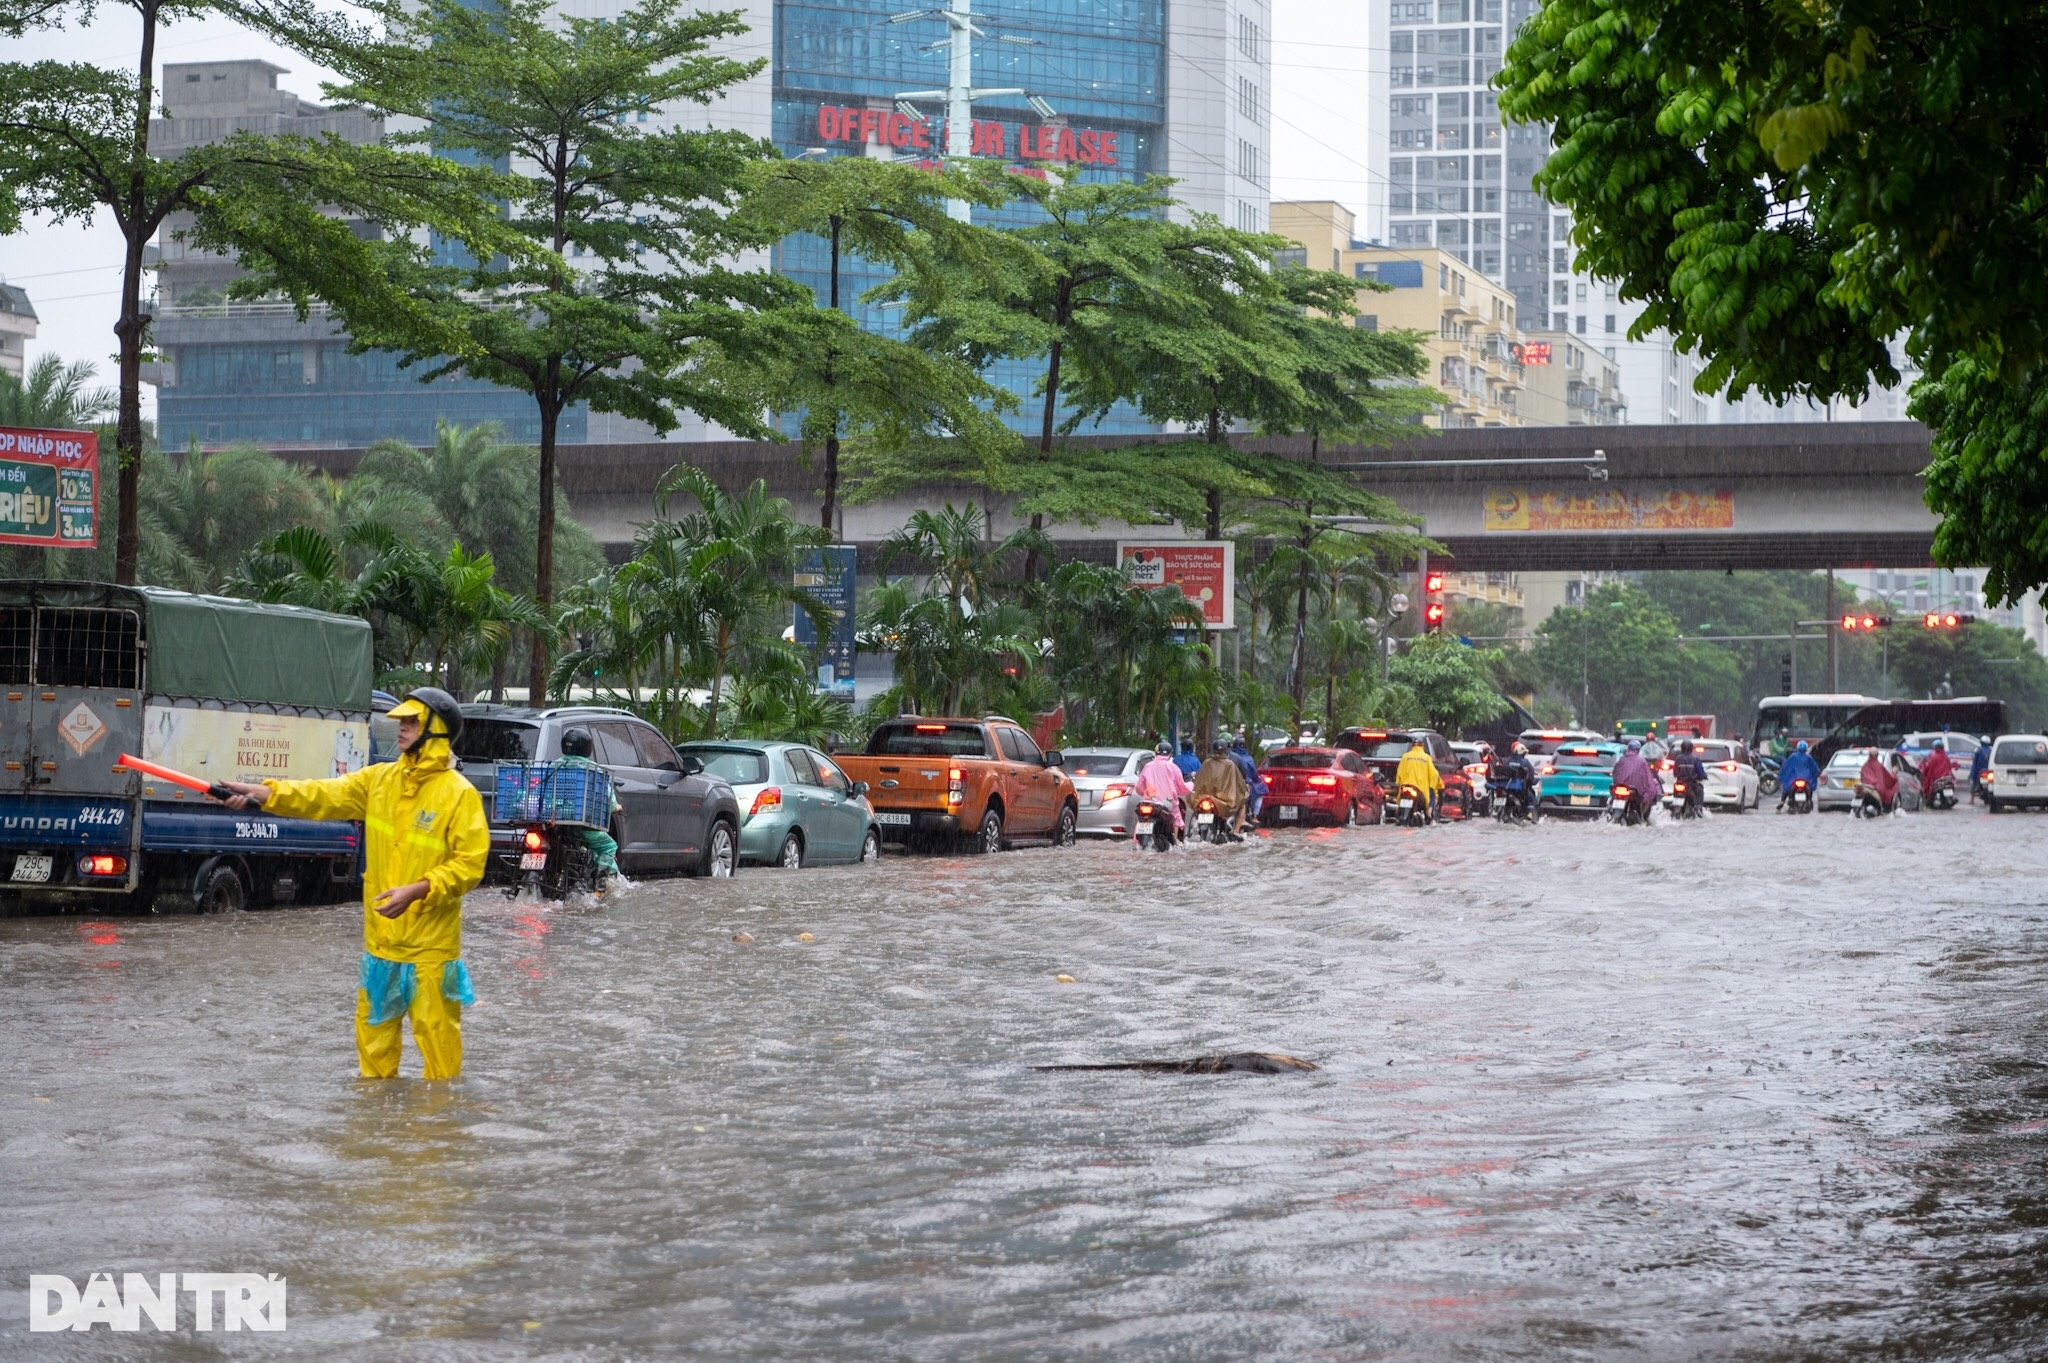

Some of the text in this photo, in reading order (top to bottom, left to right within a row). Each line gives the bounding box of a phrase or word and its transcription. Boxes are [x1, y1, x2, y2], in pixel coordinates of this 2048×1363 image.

[818, 105, 929, 148] OFFICE
[1019, 124, 1117, 165] LEASE
[17, 433, 53, 459] NHẬP
[56, 440, 82, 462] HỌC
[8, 465, 26, 483] ĐẾN
[61, 478, 91, 500] 10 %
[0, 485, 51, 531] RIỆU
[62, 514, 94, 537] 3 NĂ
[1174, 553, 1192, 562] THỰC
[811, 575, 824, 585] 18
[1135, 571, 1154, 579] herz
[238, 737, 250, 748] BIA
[237, 751, 260, 767] KEG
[263, 752, 269, 767] 2
[0, 816, 76, 831] UNDAI
[79, 806, 125, 825] 344.79
[235, 822, 278, 838] 29C-344.79
[24, 856, 43, 870] 29C
[12, 869, 49, 881] 344.79
